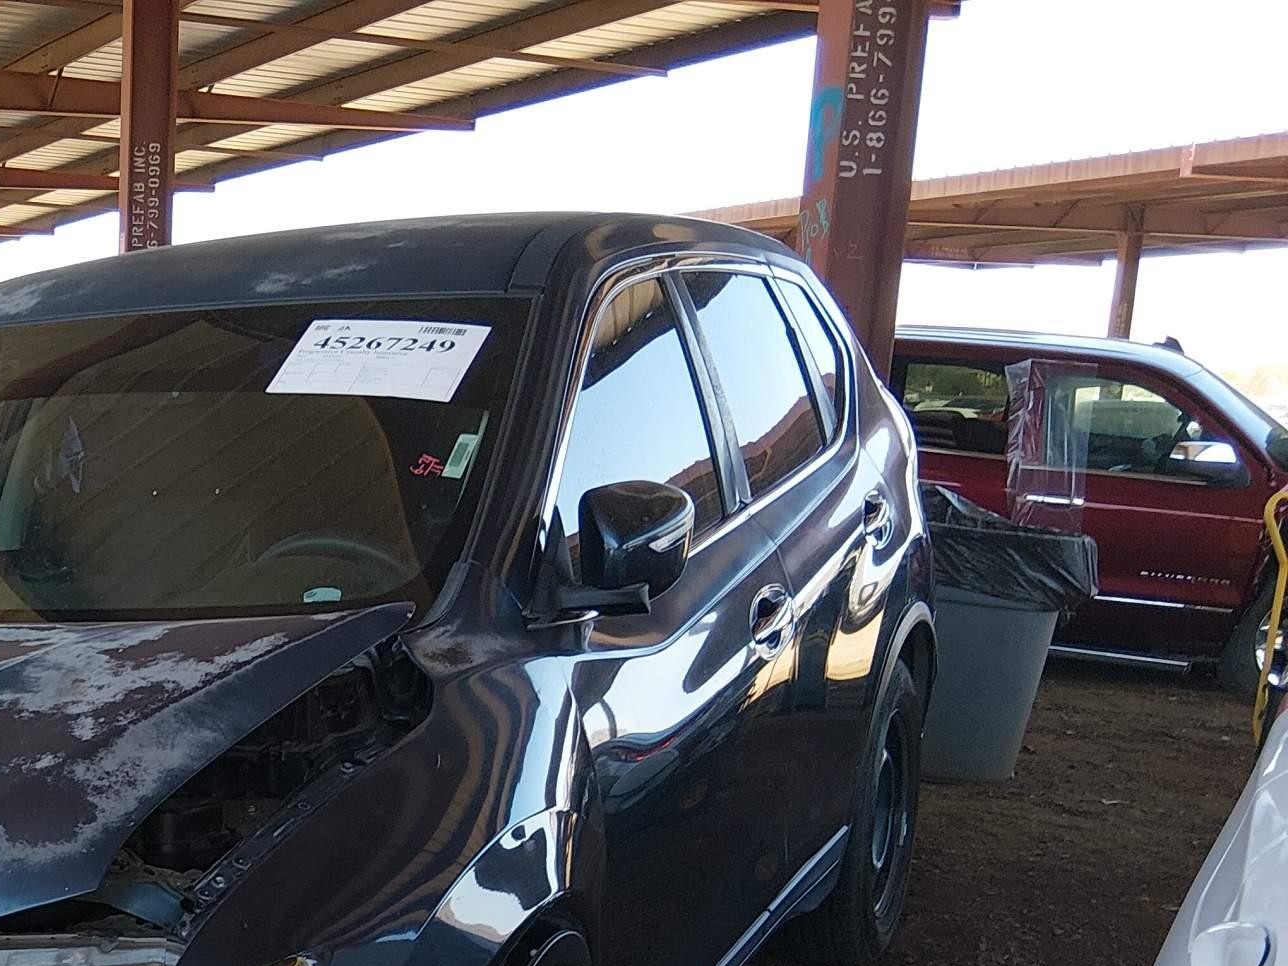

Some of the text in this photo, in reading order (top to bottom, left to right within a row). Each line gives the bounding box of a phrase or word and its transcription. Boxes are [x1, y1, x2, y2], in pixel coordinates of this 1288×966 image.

[838, 119, 863, 179] U.S.
[132, 140, 147, 247] PREFAB INC.
[313, 335, 457, 353] 45267249
